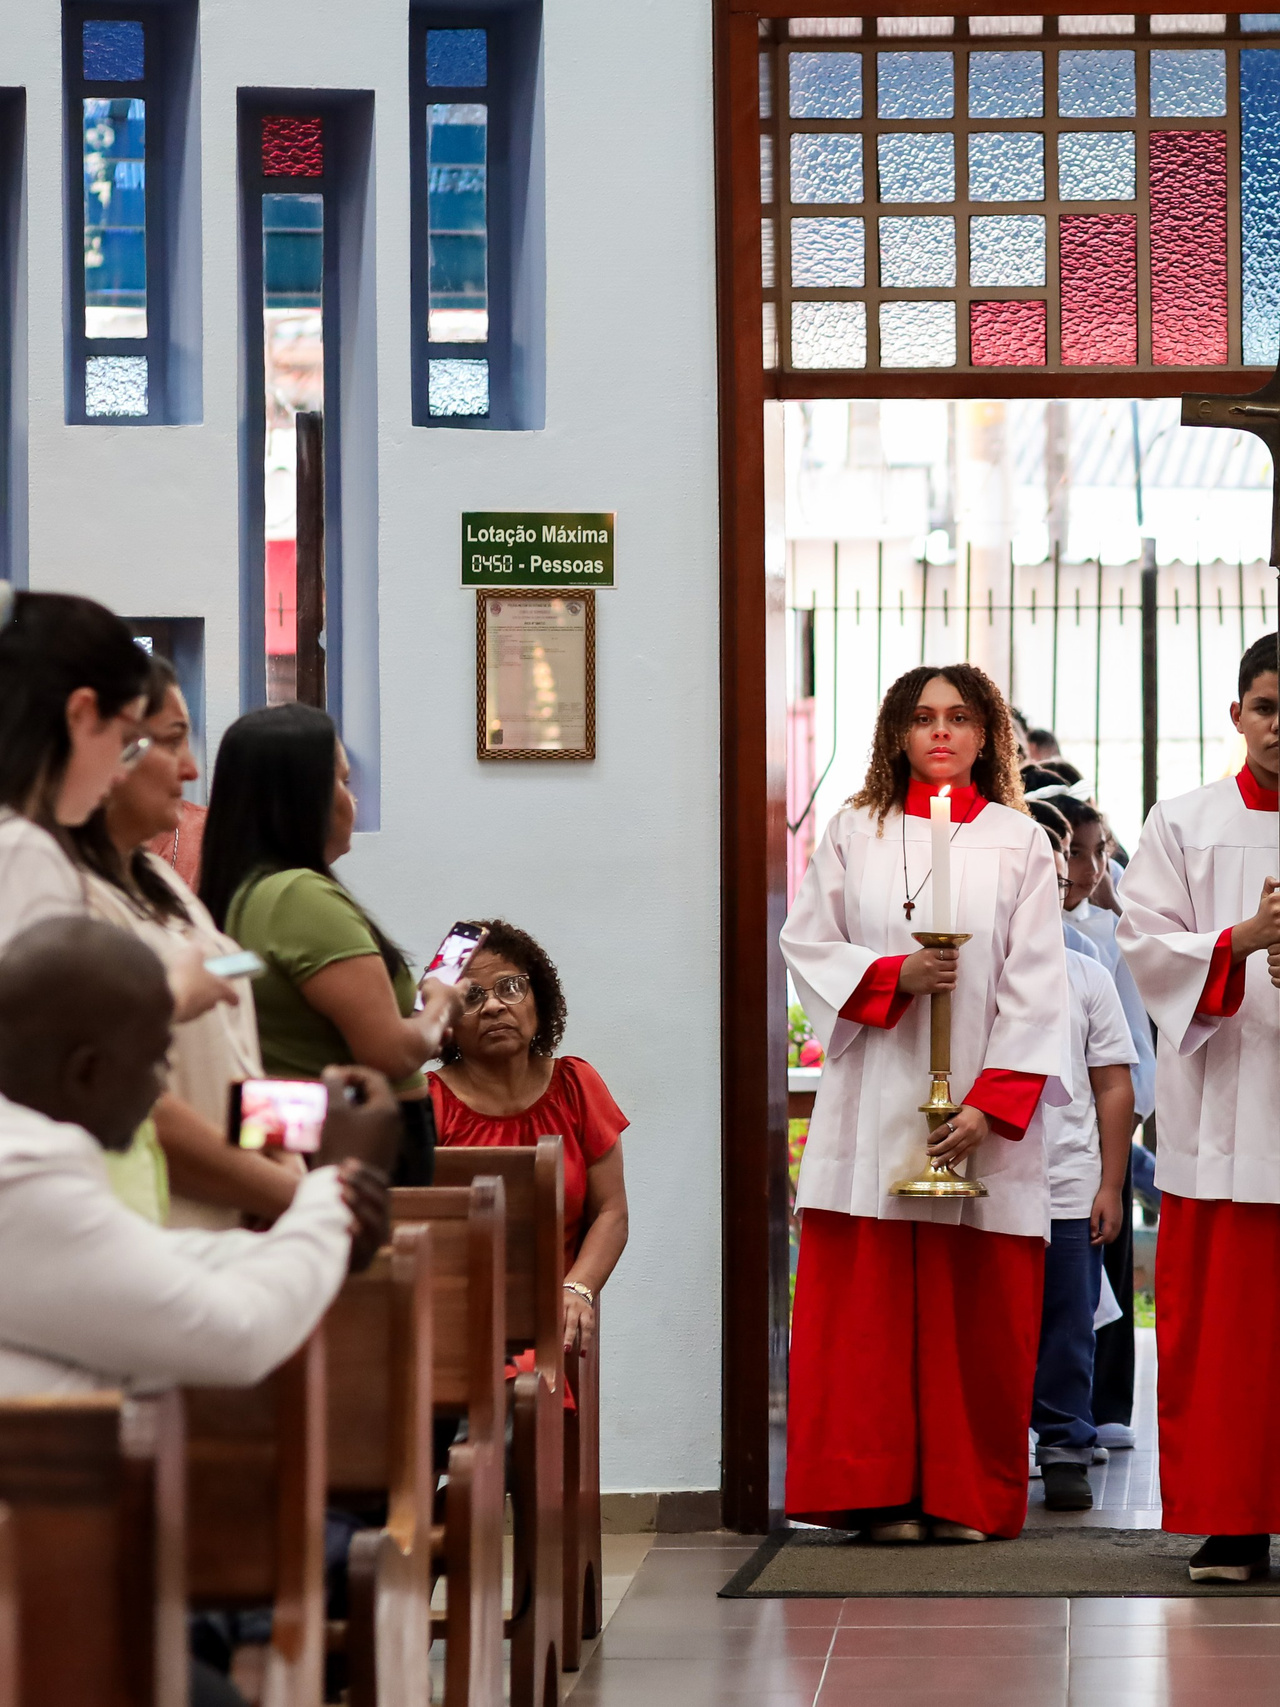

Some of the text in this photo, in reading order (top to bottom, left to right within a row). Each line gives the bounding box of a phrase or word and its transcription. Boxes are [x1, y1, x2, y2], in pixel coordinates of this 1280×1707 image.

[467, 524, 608, 547] Lotação Máxima
[471, 555, 513, 573] 0450
[530, 555, 604, 573] Pessoas
